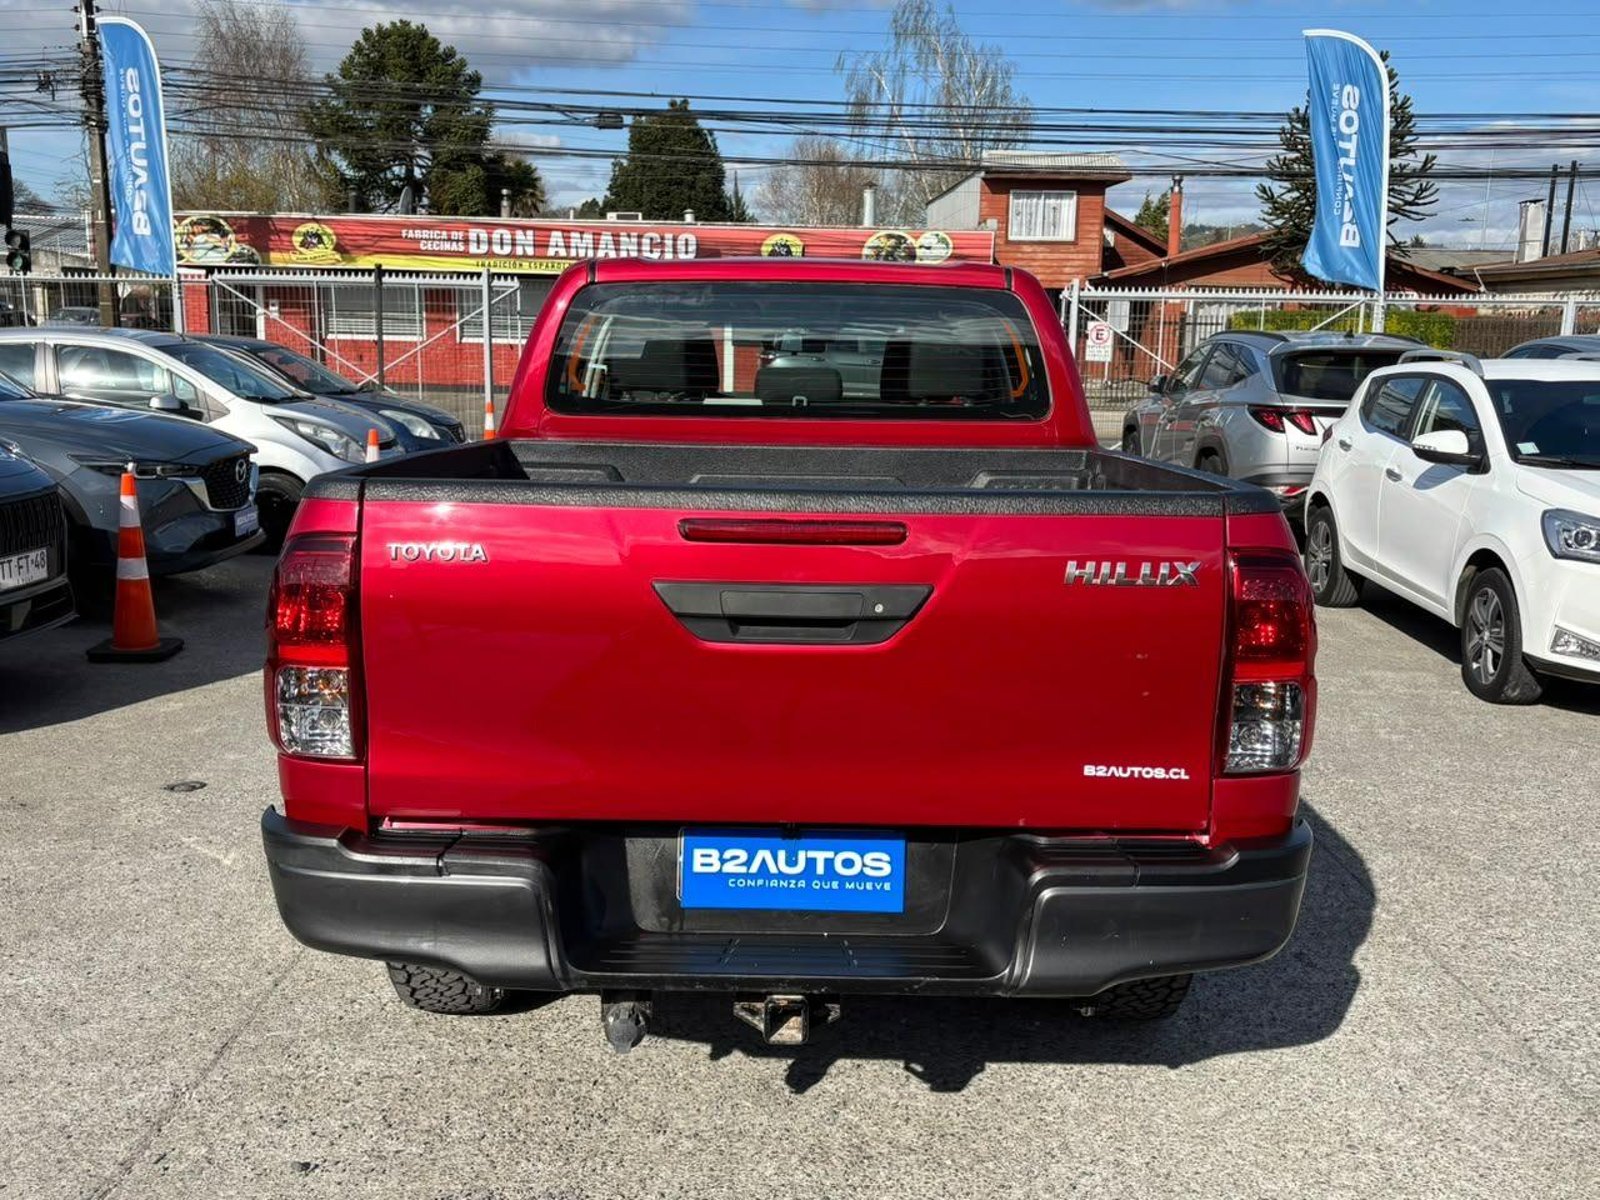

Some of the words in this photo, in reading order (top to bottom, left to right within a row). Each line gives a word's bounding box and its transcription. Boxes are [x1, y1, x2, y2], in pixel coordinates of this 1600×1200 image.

[401, 229, 448, 239] FABRICA
[450, 230, 464, 240] DE
[420, 240, 464, 251] CECINAS
[468, 228, 535, 256] DON
[546, 230, 697, 260] AMANCIO
[1095, 328, 1105, 341] E
[386, 541, 489, 563] TOYOTA
[1064, 560, 1201, 587] HILUX
[1083, 765, 1190, 780] B2AUTOS.CL
[692, 847, 892, 877] B2AUTOS
[728, 878, 806, 889] CONFIANZA
[811, 880, 839, 890] QUE
[845, 881, 892, 891] MUEVE
